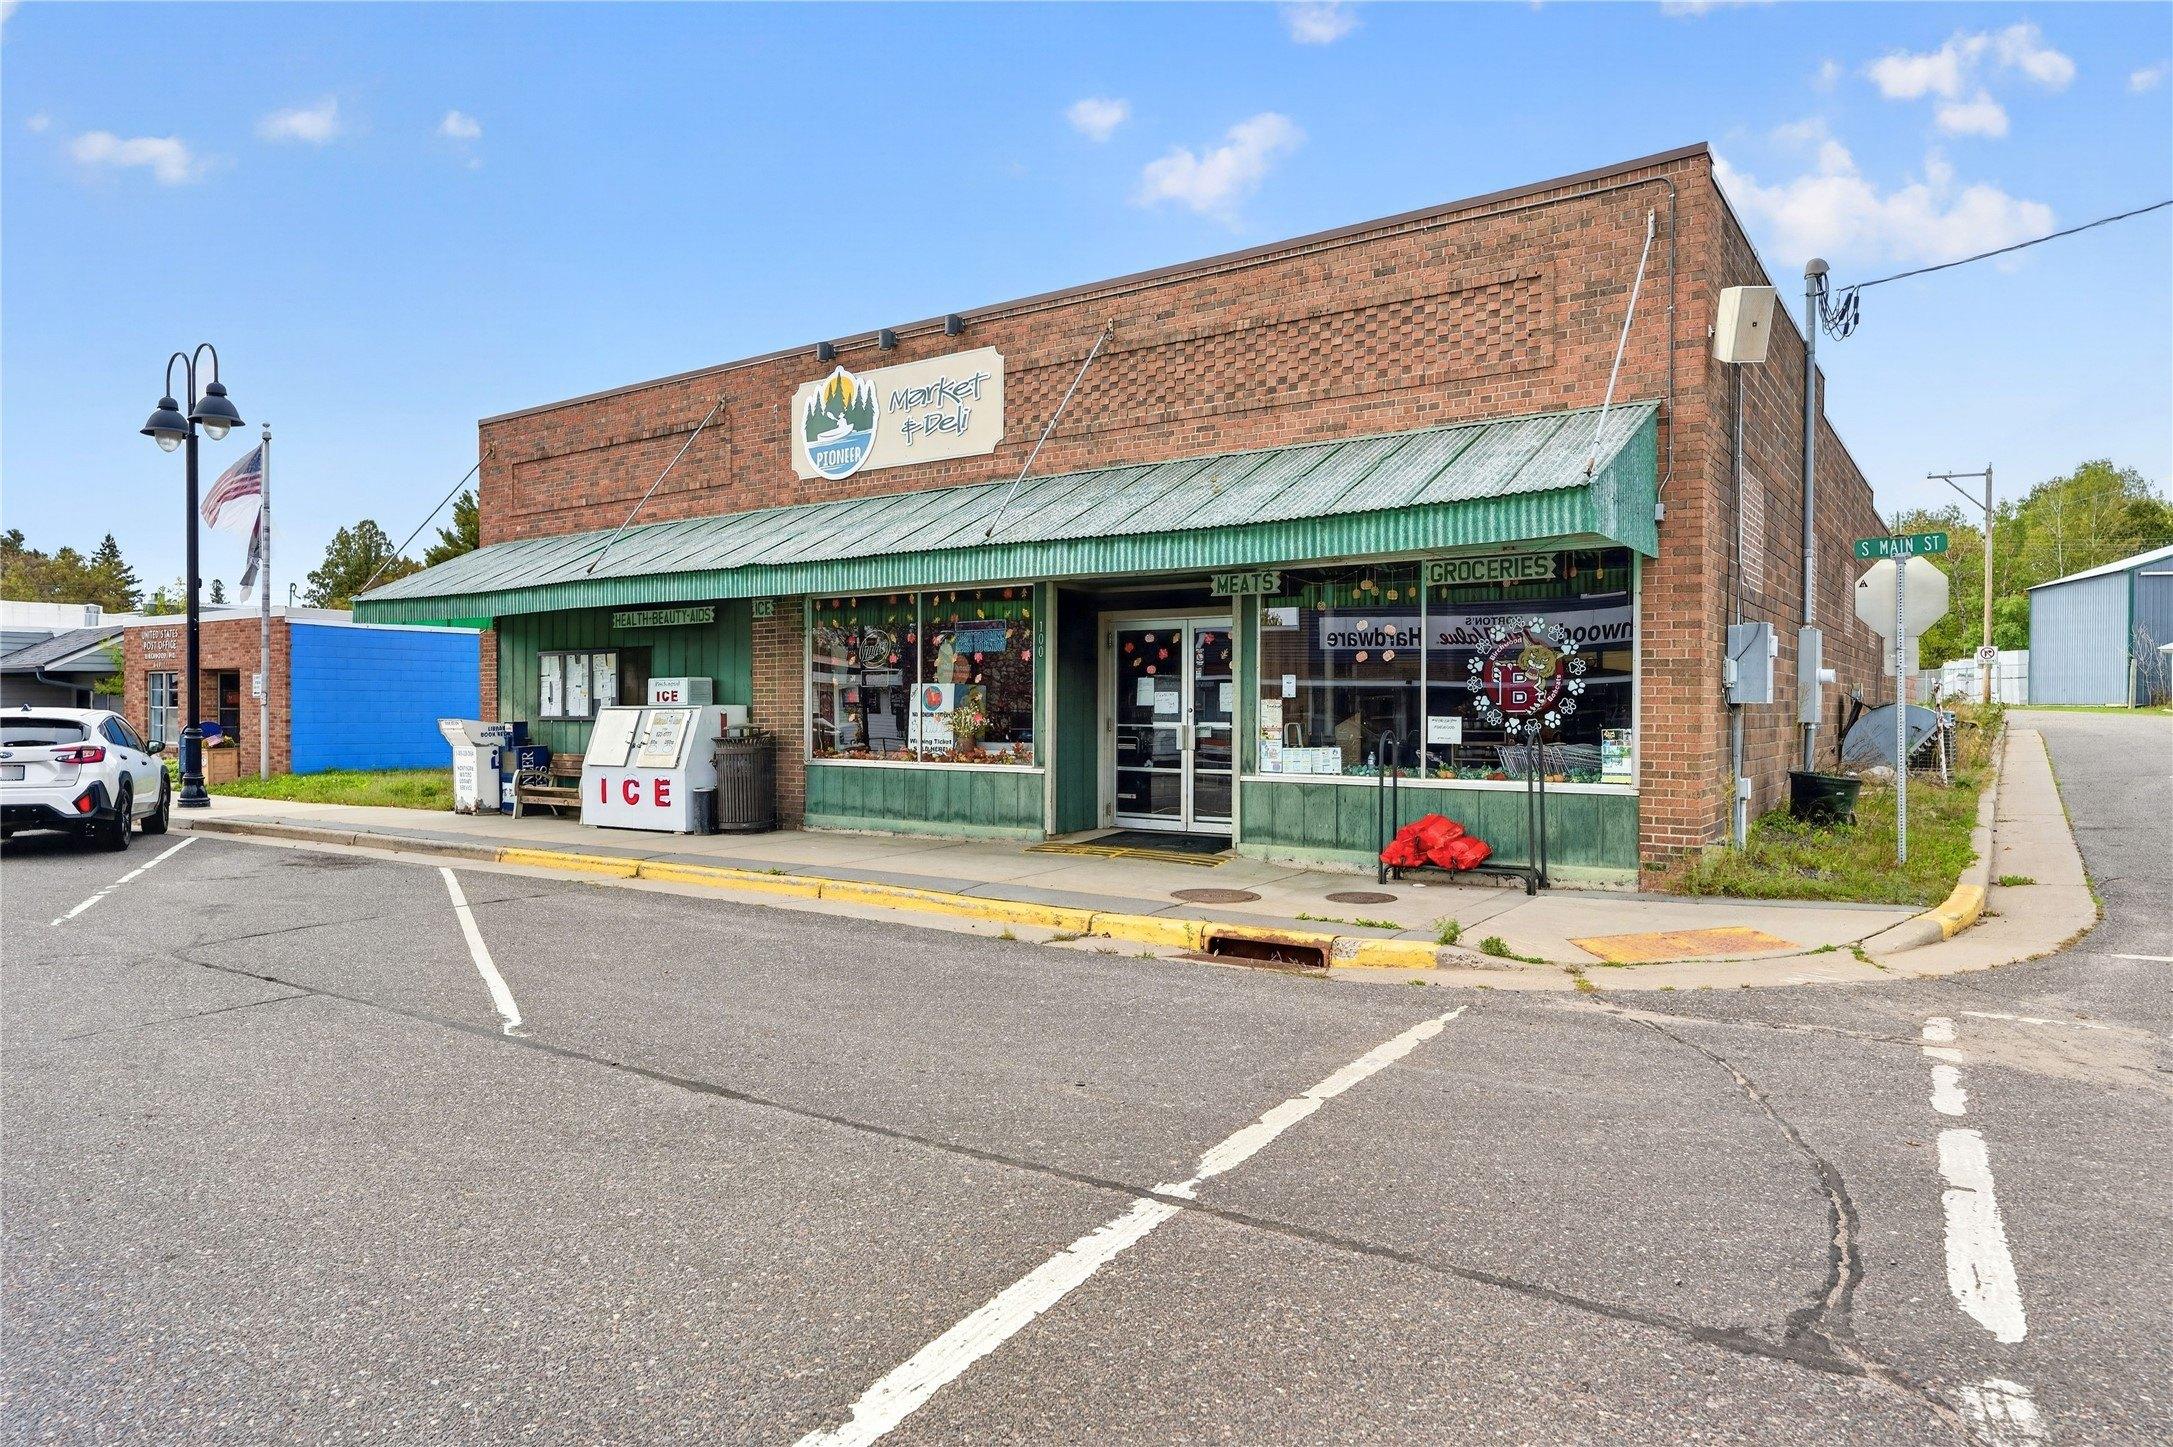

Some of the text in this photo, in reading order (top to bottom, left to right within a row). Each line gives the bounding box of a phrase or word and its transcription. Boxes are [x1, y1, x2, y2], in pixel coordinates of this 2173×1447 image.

[888, 372, 991, 413] Market
[901, 405, 971, 446] & Deli
[816, 445, 861, 466] PIONEER
[1861, 535, 1940, 557] S MAIN ST
[1429, 555, 1549, 583] GROCERIES
[1216, 571, 1274, 594] MEATS
[754, 601, 772, 616] ICE
[656, 690, 679, 702] ICE
[600, 775, 672, 808] ICE
